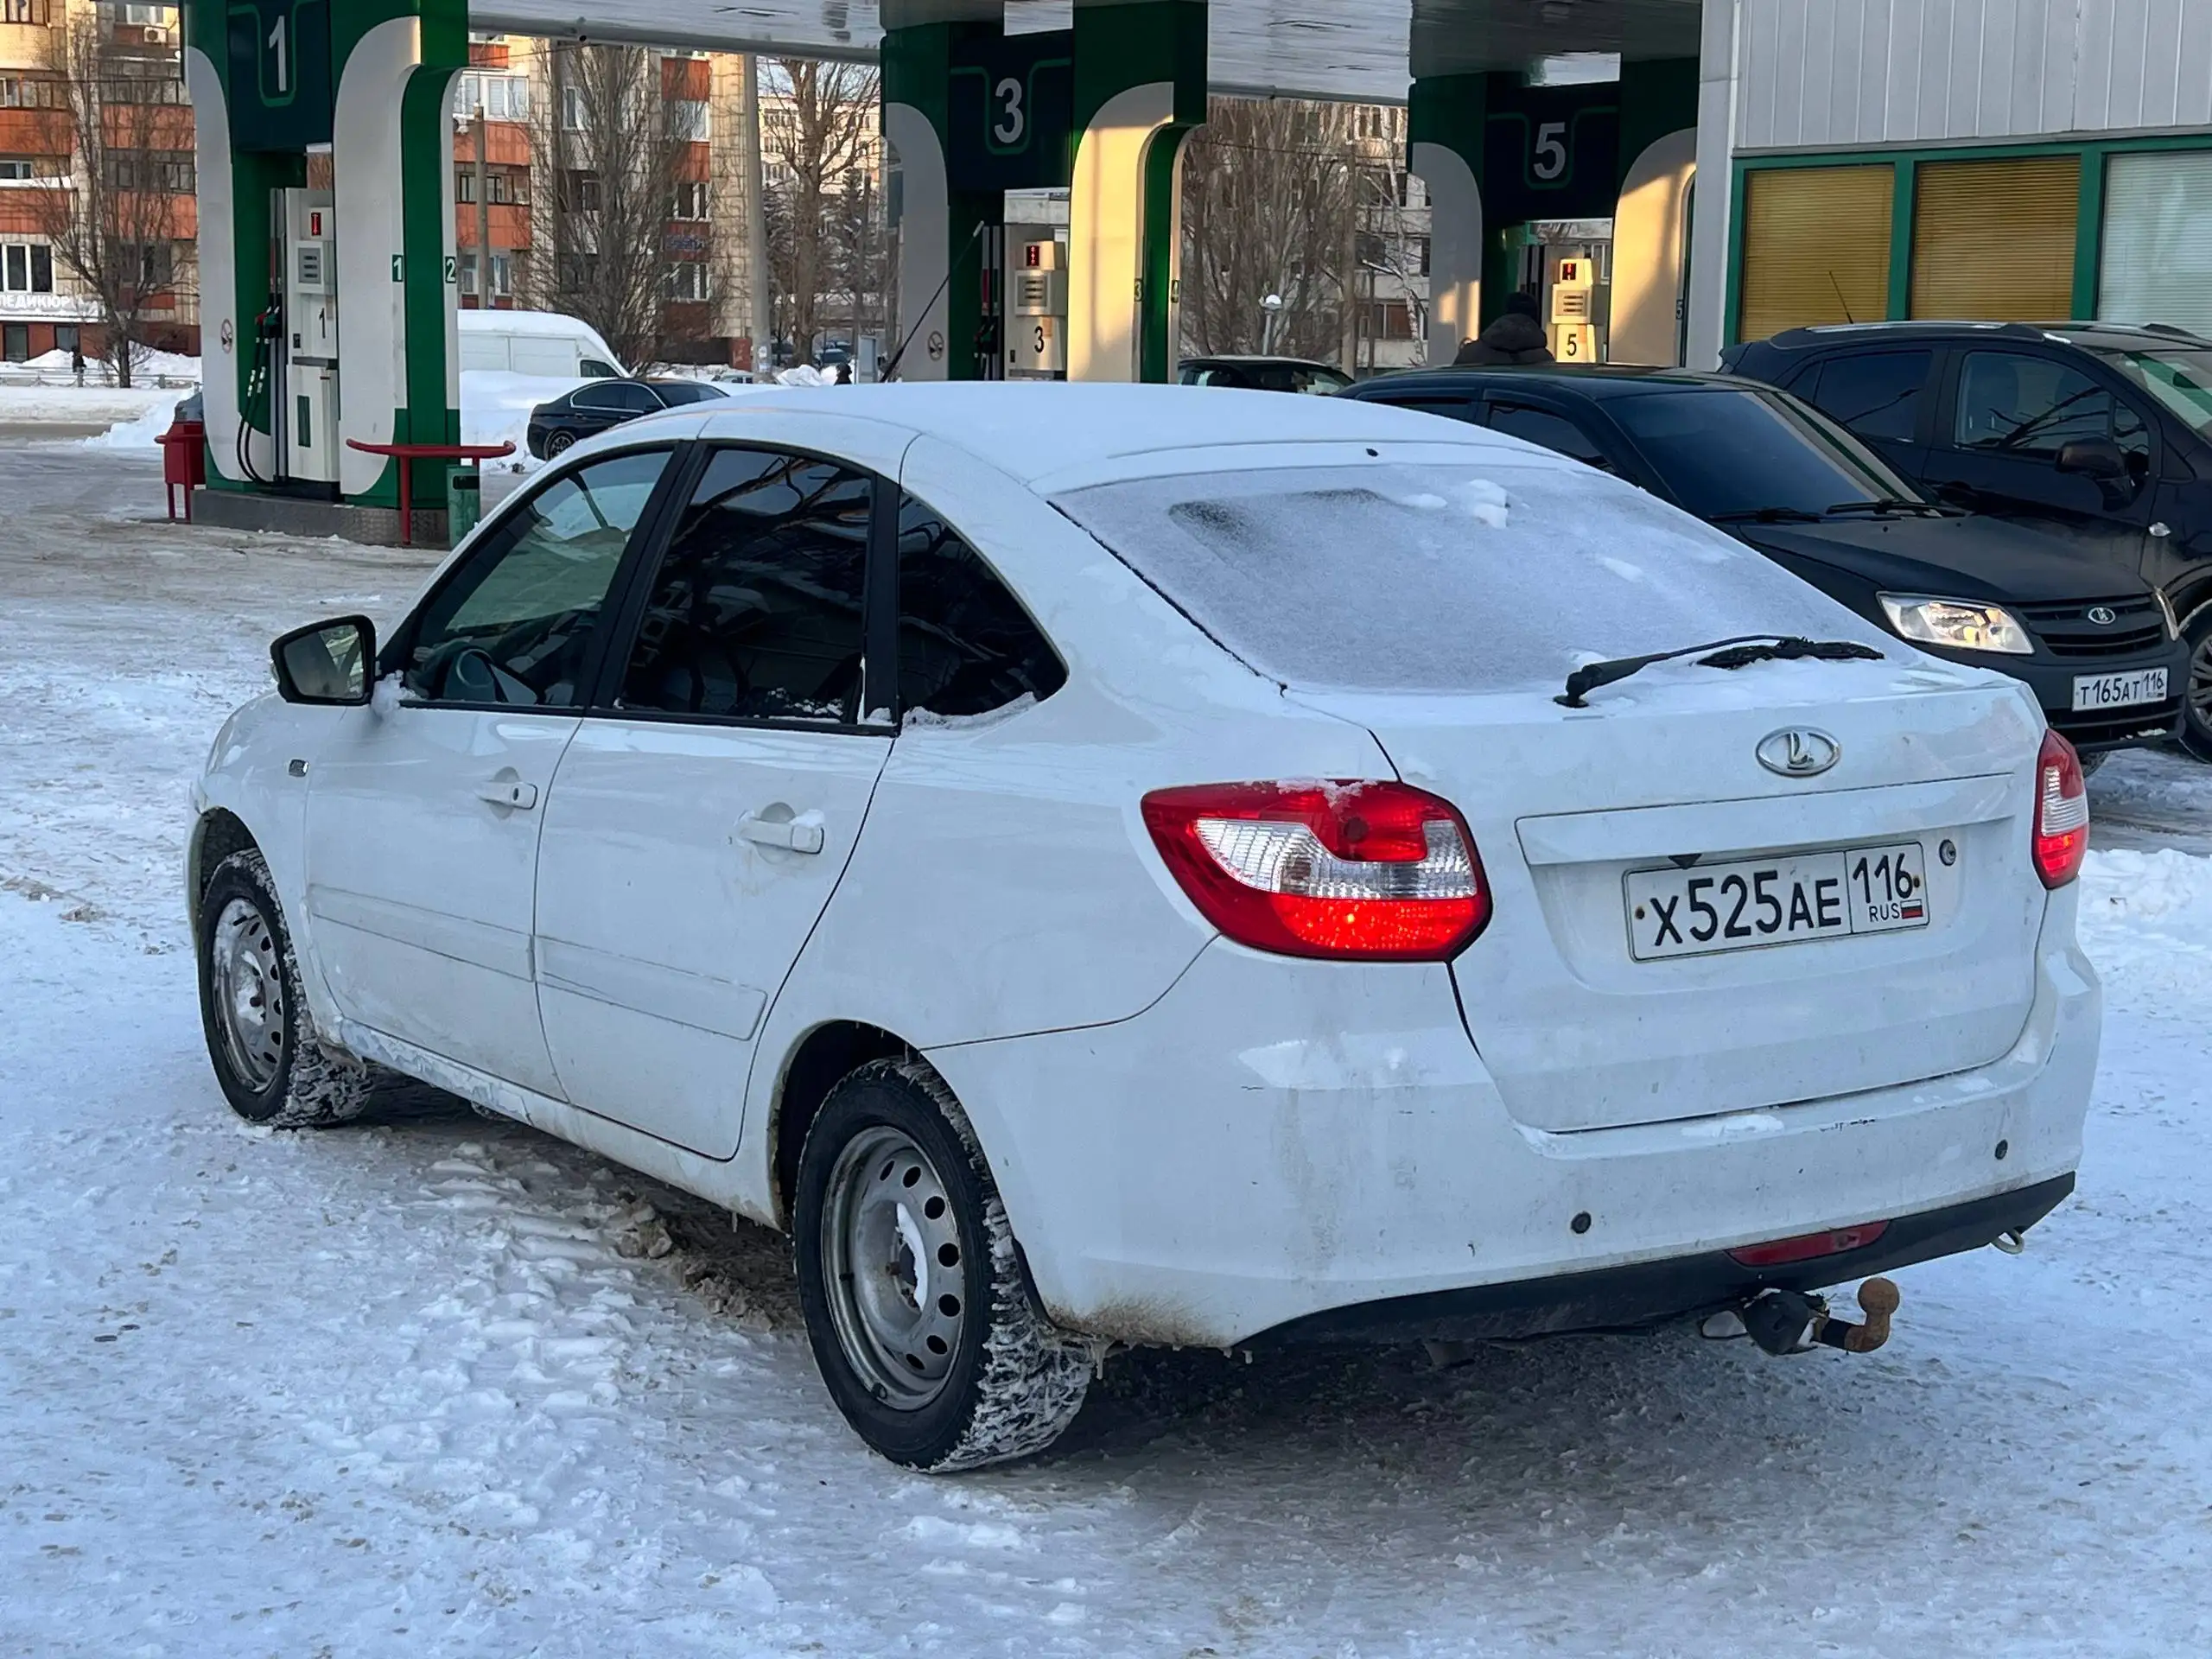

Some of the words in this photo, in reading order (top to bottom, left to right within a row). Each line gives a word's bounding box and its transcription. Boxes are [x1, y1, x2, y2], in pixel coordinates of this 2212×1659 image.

[269, 15, 287, 92] 1
[994, 77, 1024, 143] 3
[1533, 121, 1566, 179] 5
[393, 257, 403, 281] 1
[446, 258, 456, 282] 2
[1134, 280, 1142, 302] 3
[319, 308, 327, 339] 1
[1034, 326, 1045, 353] 3
[1566, 334, 1577, 356] 5
[2144, 671, 2164, 692] 116
[1649, 869, 1841, 946] Х525АЕ
[1853, 853, 1913, 904] 116
[1869, 902, 1900, 922] RUS
